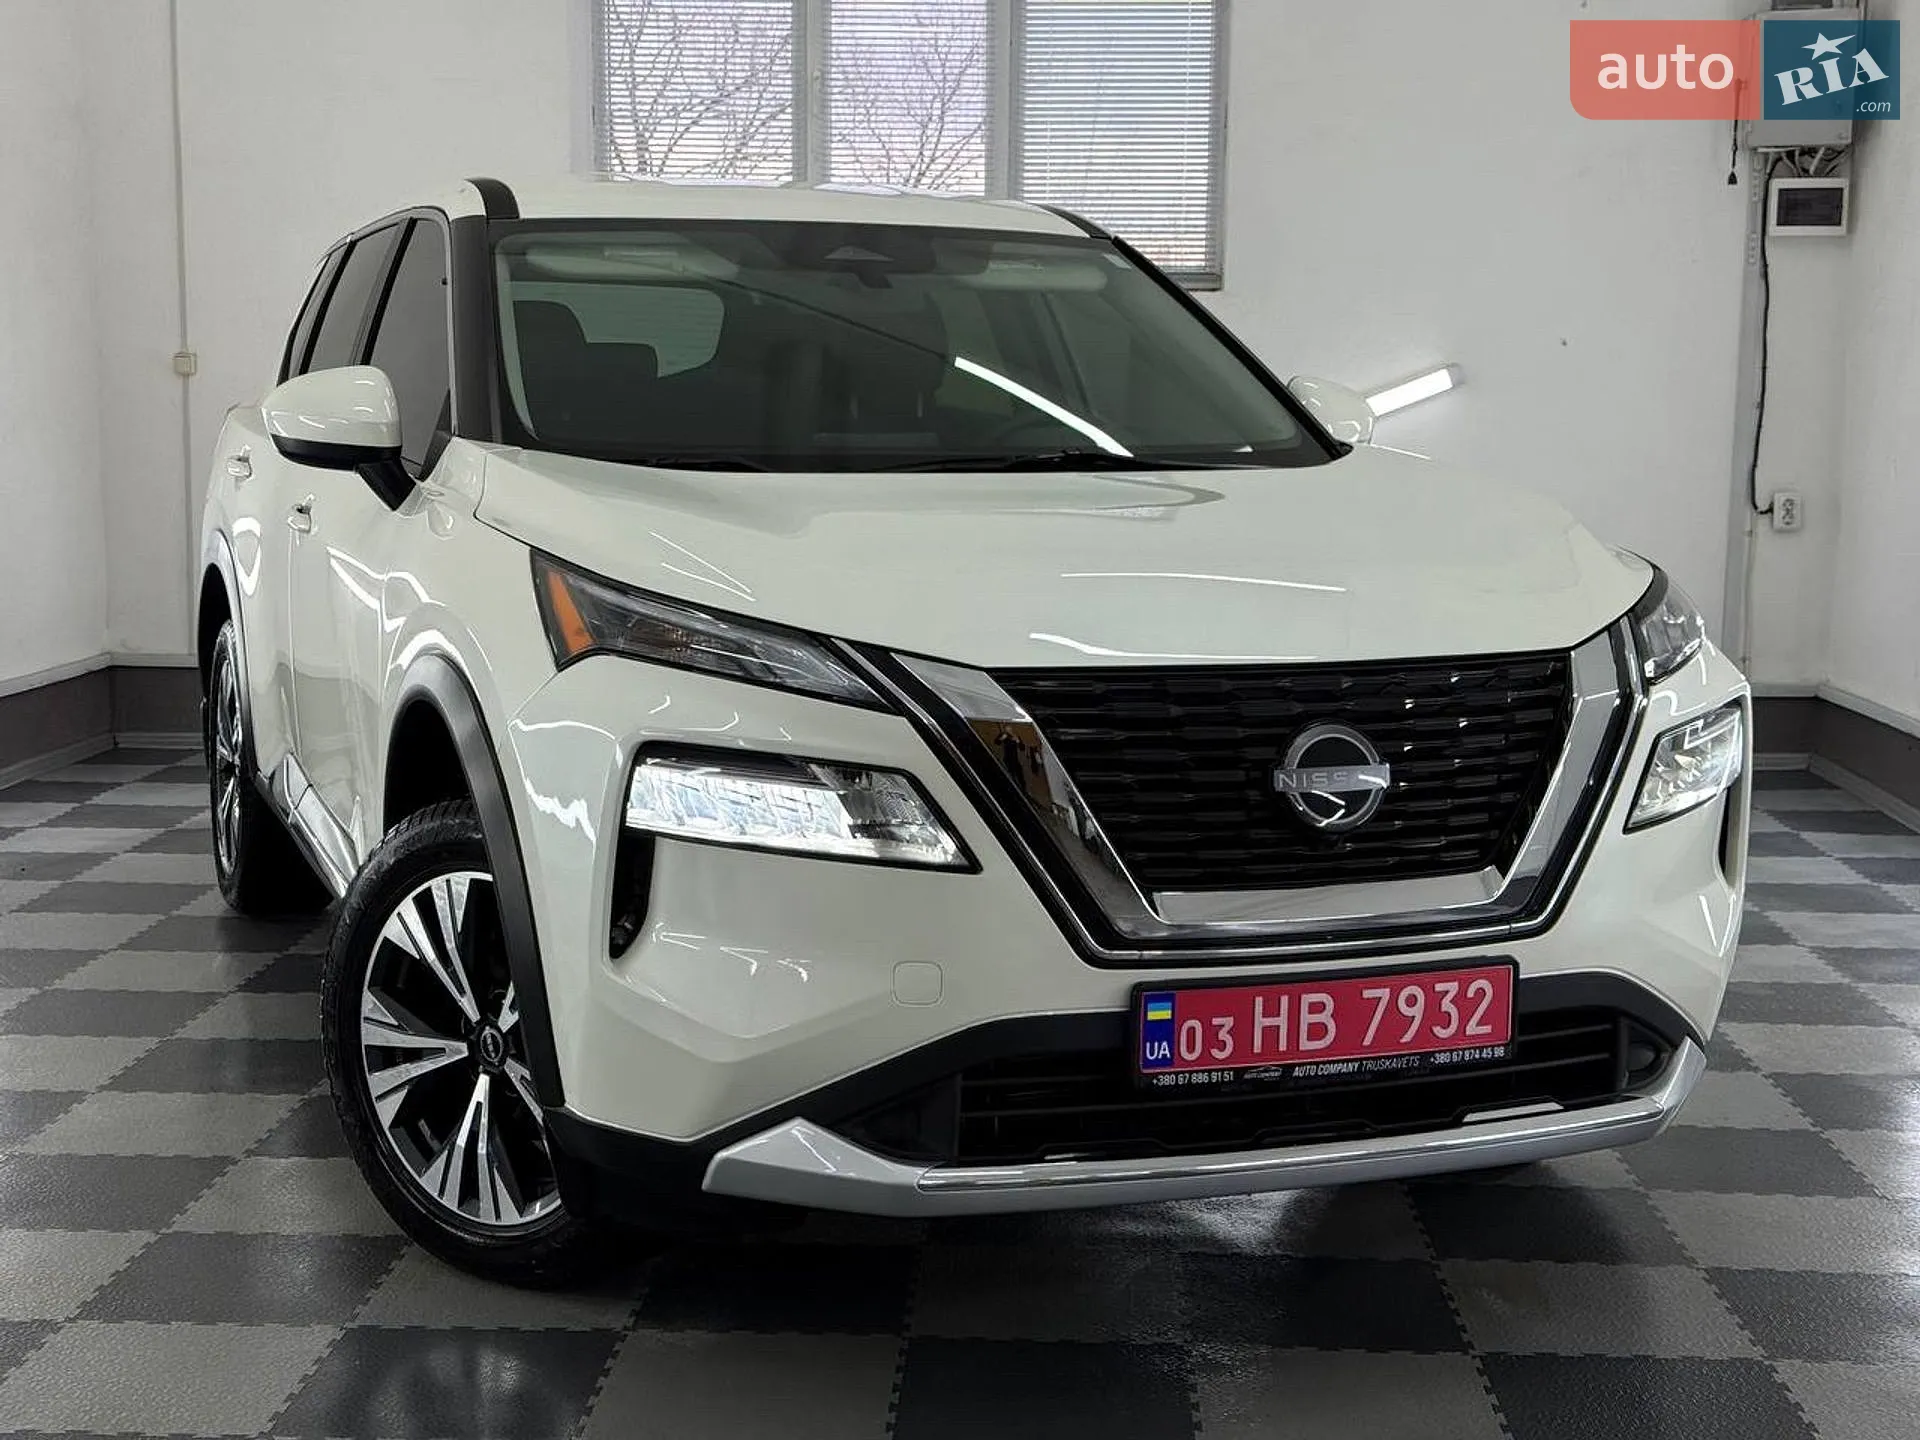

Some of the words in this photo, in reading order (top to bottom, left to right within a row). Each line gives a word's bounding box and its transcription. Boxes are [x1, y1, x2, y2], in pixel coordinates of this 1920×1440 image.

[1179, 1016, 1235, 1062] 03
[1252, 992, 1337, 1053] HB
[1361, 978, 1494, 1047] 7932
[1145, 1040, 1171, 1060] UA
[1292, 1065, 1317, 1078] AUTO
[1317, 1061, 1360, 1076] COMPANY
[1361, 1056, 1420, 1073] TRUSKAVETS
